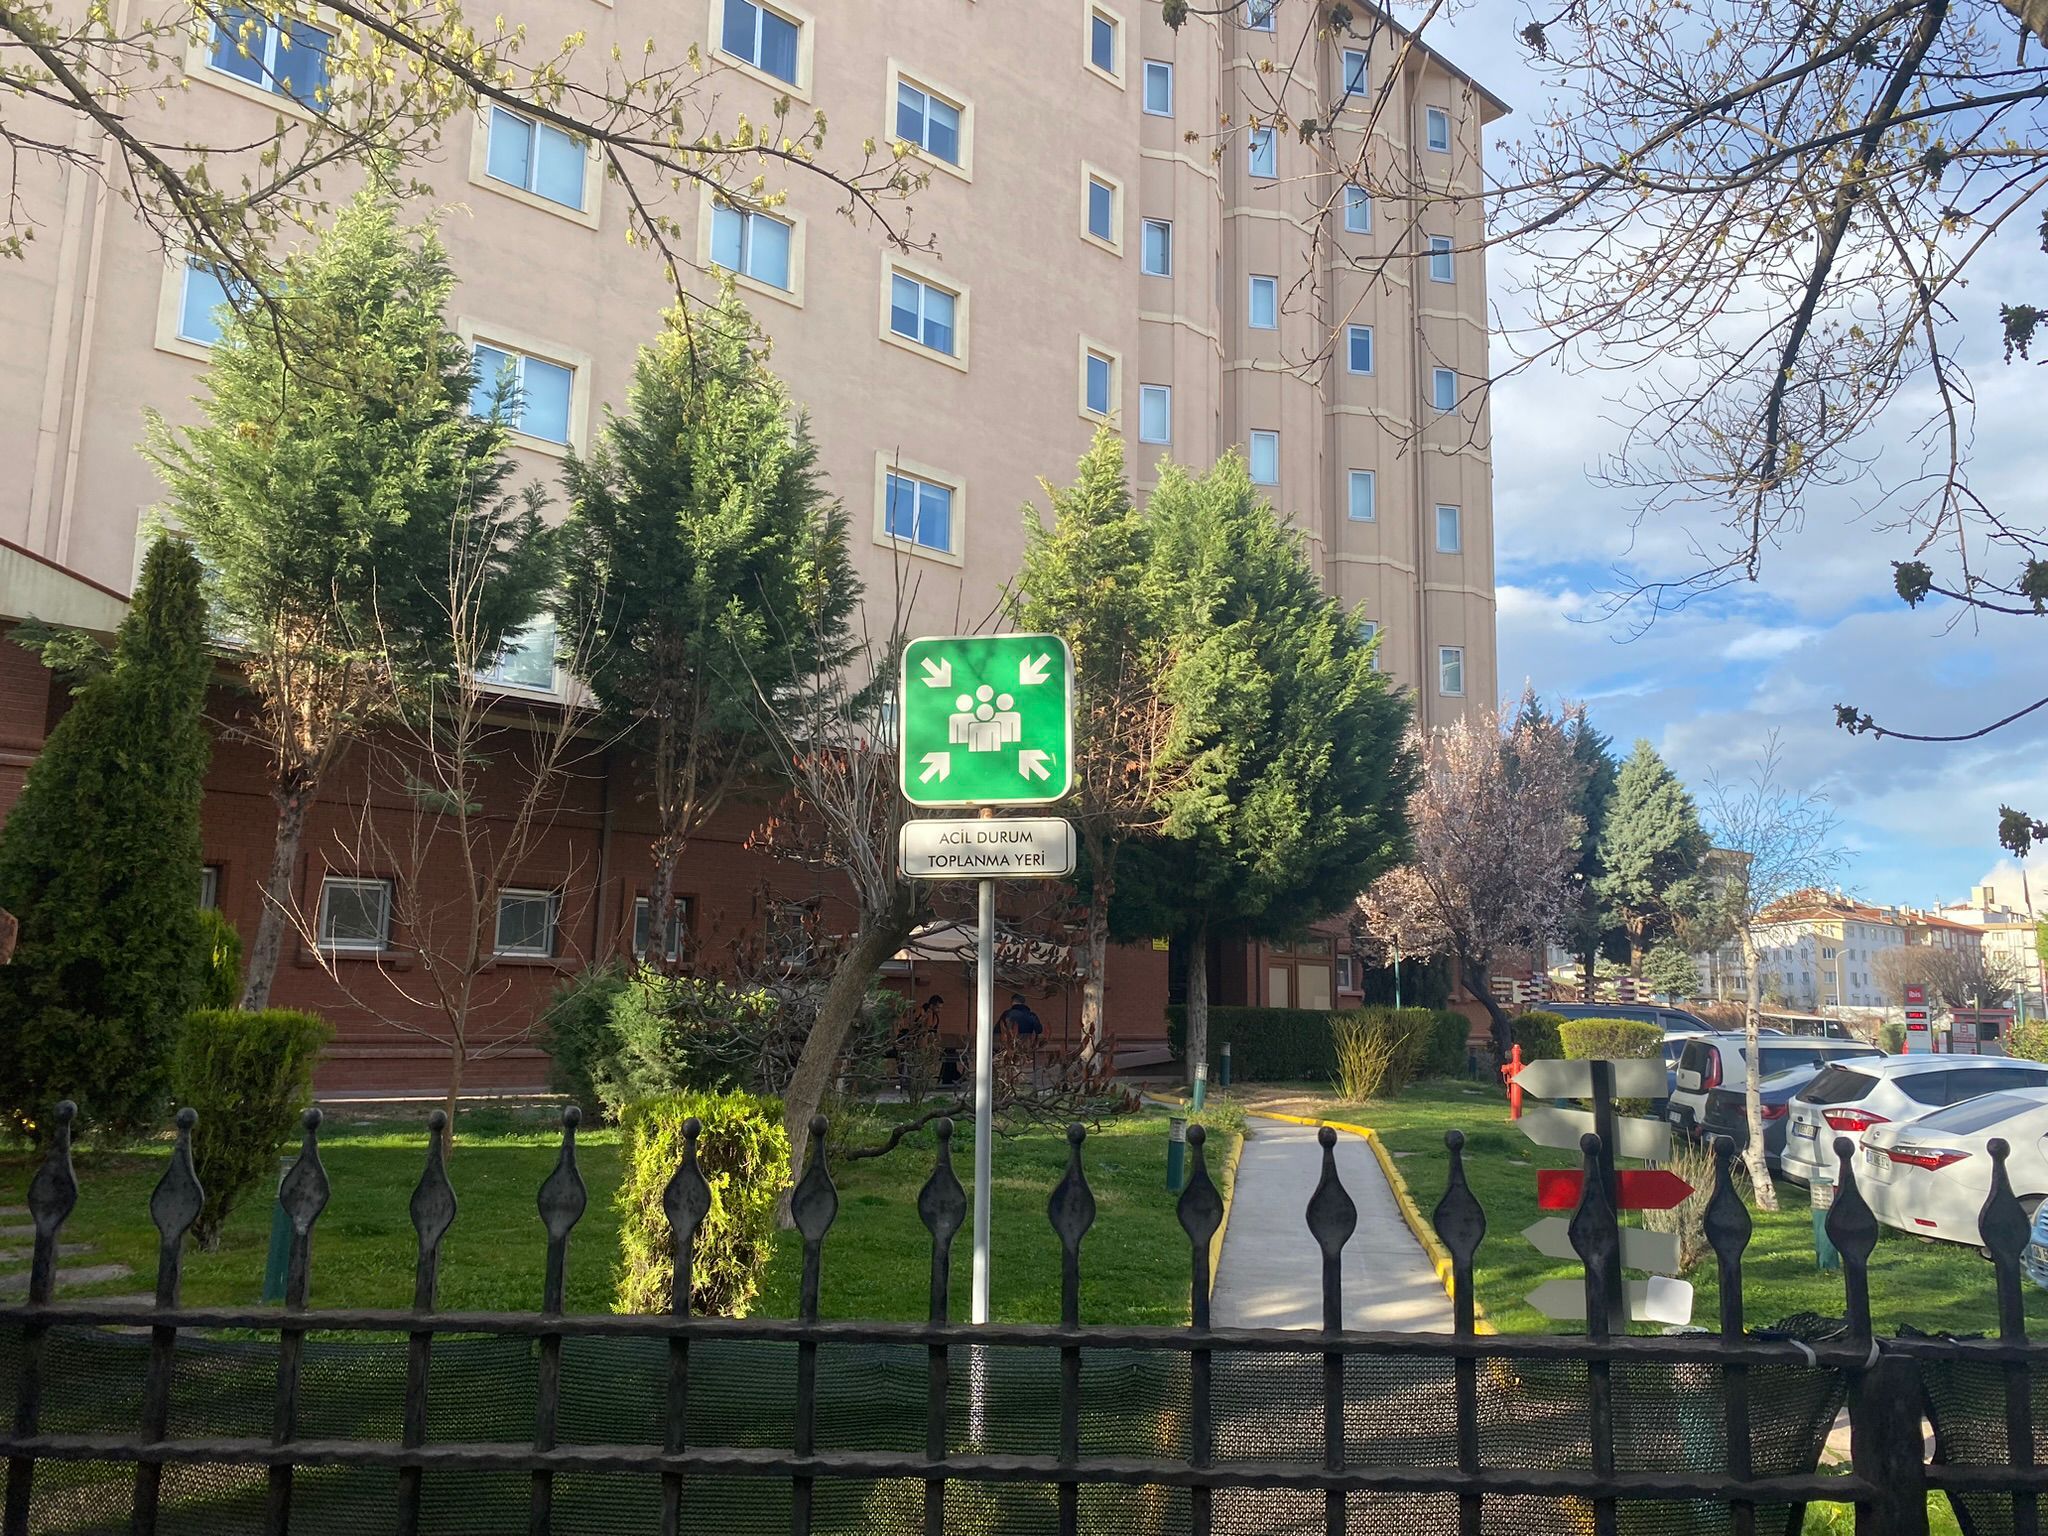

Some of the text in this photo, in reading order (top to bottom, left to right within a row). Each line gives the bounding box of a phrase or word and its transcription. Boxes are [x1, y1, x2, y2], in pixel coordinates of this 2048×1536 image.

[939, 828, 1033, 845] ACİL DURUM
[928, 850, 1045, 868] TOPLANMA YERİ
